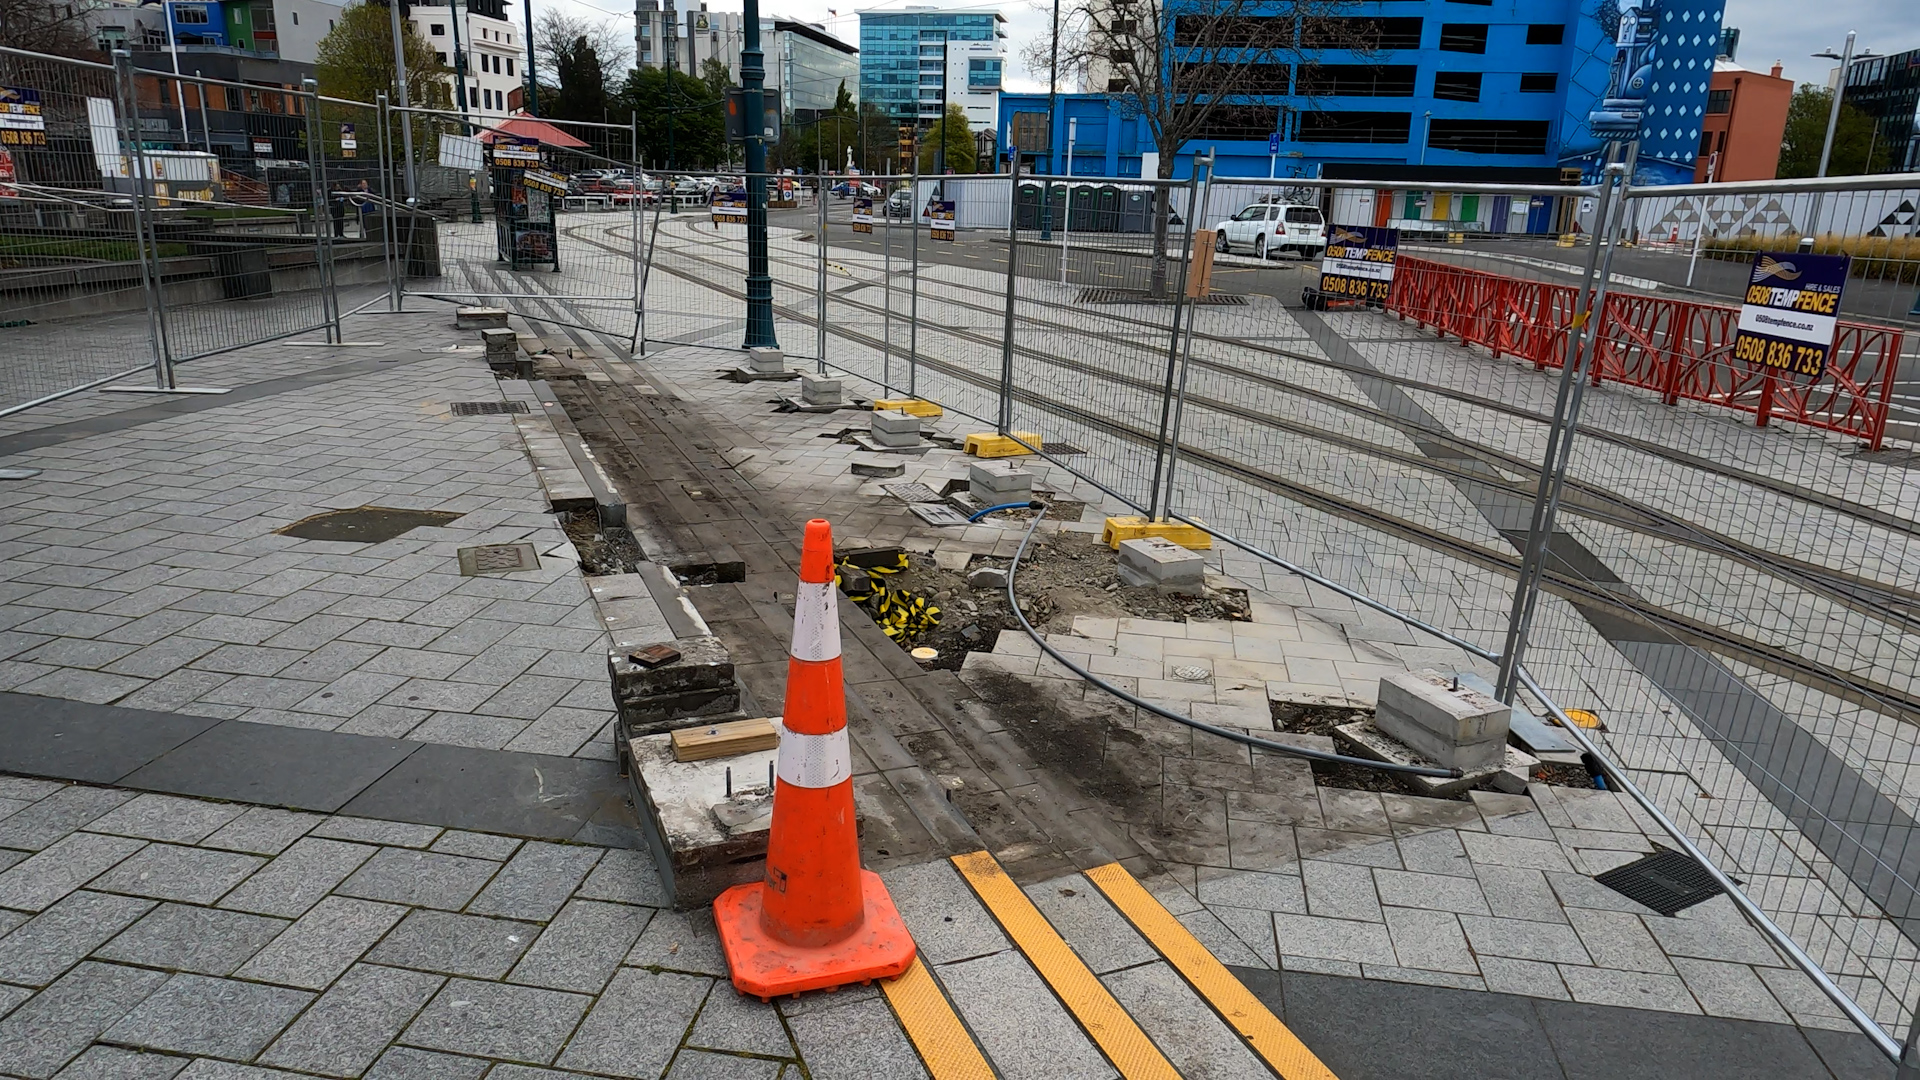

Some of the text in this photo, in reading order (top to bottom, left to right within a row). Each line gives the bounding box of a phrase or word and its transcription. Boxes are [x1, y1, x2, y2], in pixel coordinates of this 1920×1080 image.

[495, 158, 539, 168] 0508 836 733
[553, 187, 565, 197] 733
[1326, 245, 1396, 263] 0508TEMPFENCE
[1322, 276, 1389, 299] 0508 836 733
[1804, 283, 1818, 292] HIRE
[1823, 284, 1841, 294] SALES
[1746, 285, 1839, 314] 0508TEMPFENCE
[1755, 314, 1815, 332] 0508tempfence.co.nz
[1735, 334, 1823, 376] 0508 836 733
